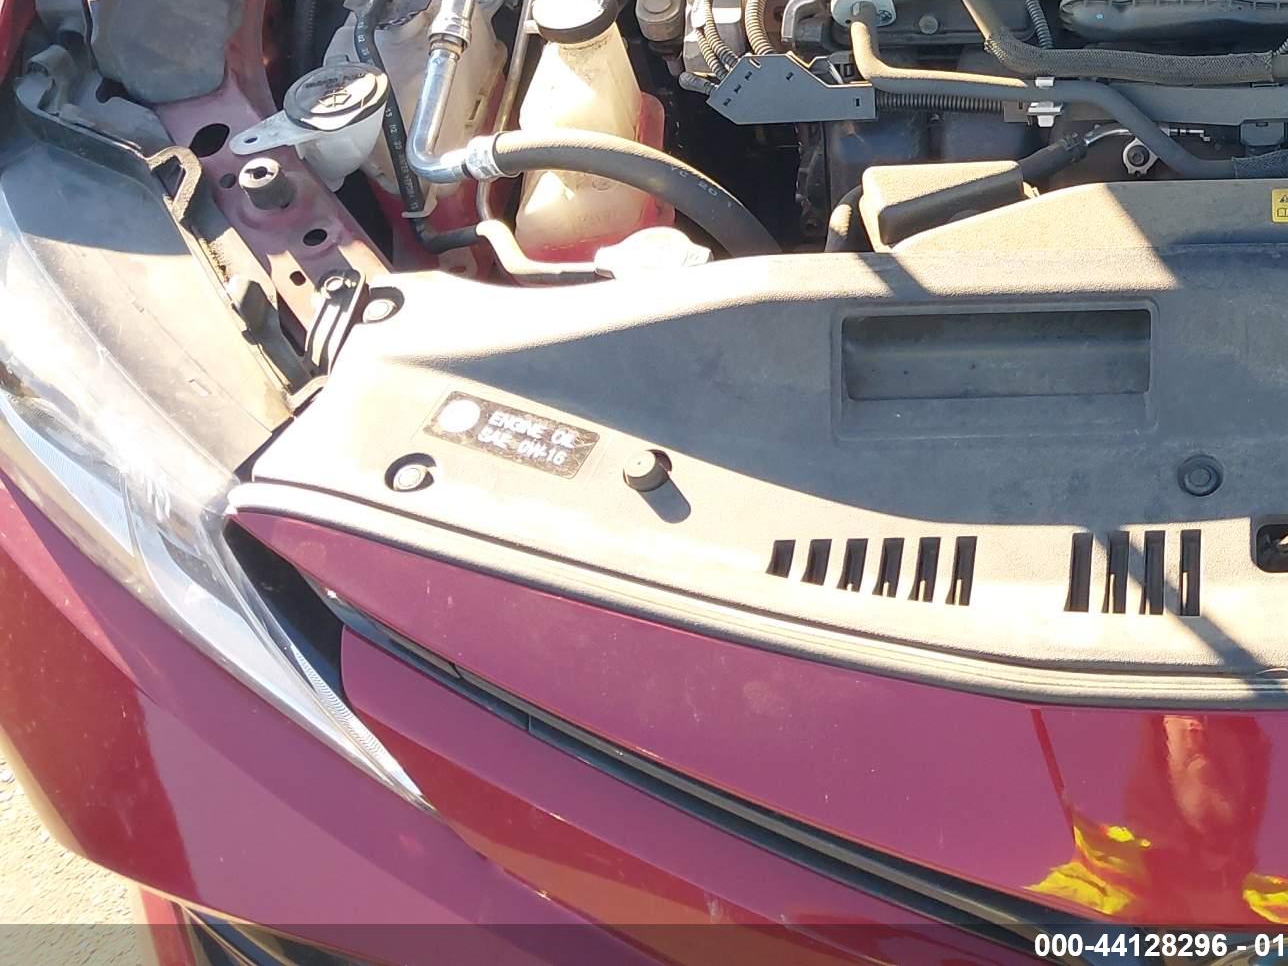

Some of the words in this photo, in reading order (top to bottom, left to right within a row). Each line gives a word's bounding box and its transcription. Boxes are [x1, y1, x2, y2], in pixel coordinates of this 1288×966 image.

[477, 425, 513, 450] SAE
[517, 438, 567, 466] 0W-16
[488, 410, 548, 439] ENGINE
[551, 424, 577, 449] OIL
